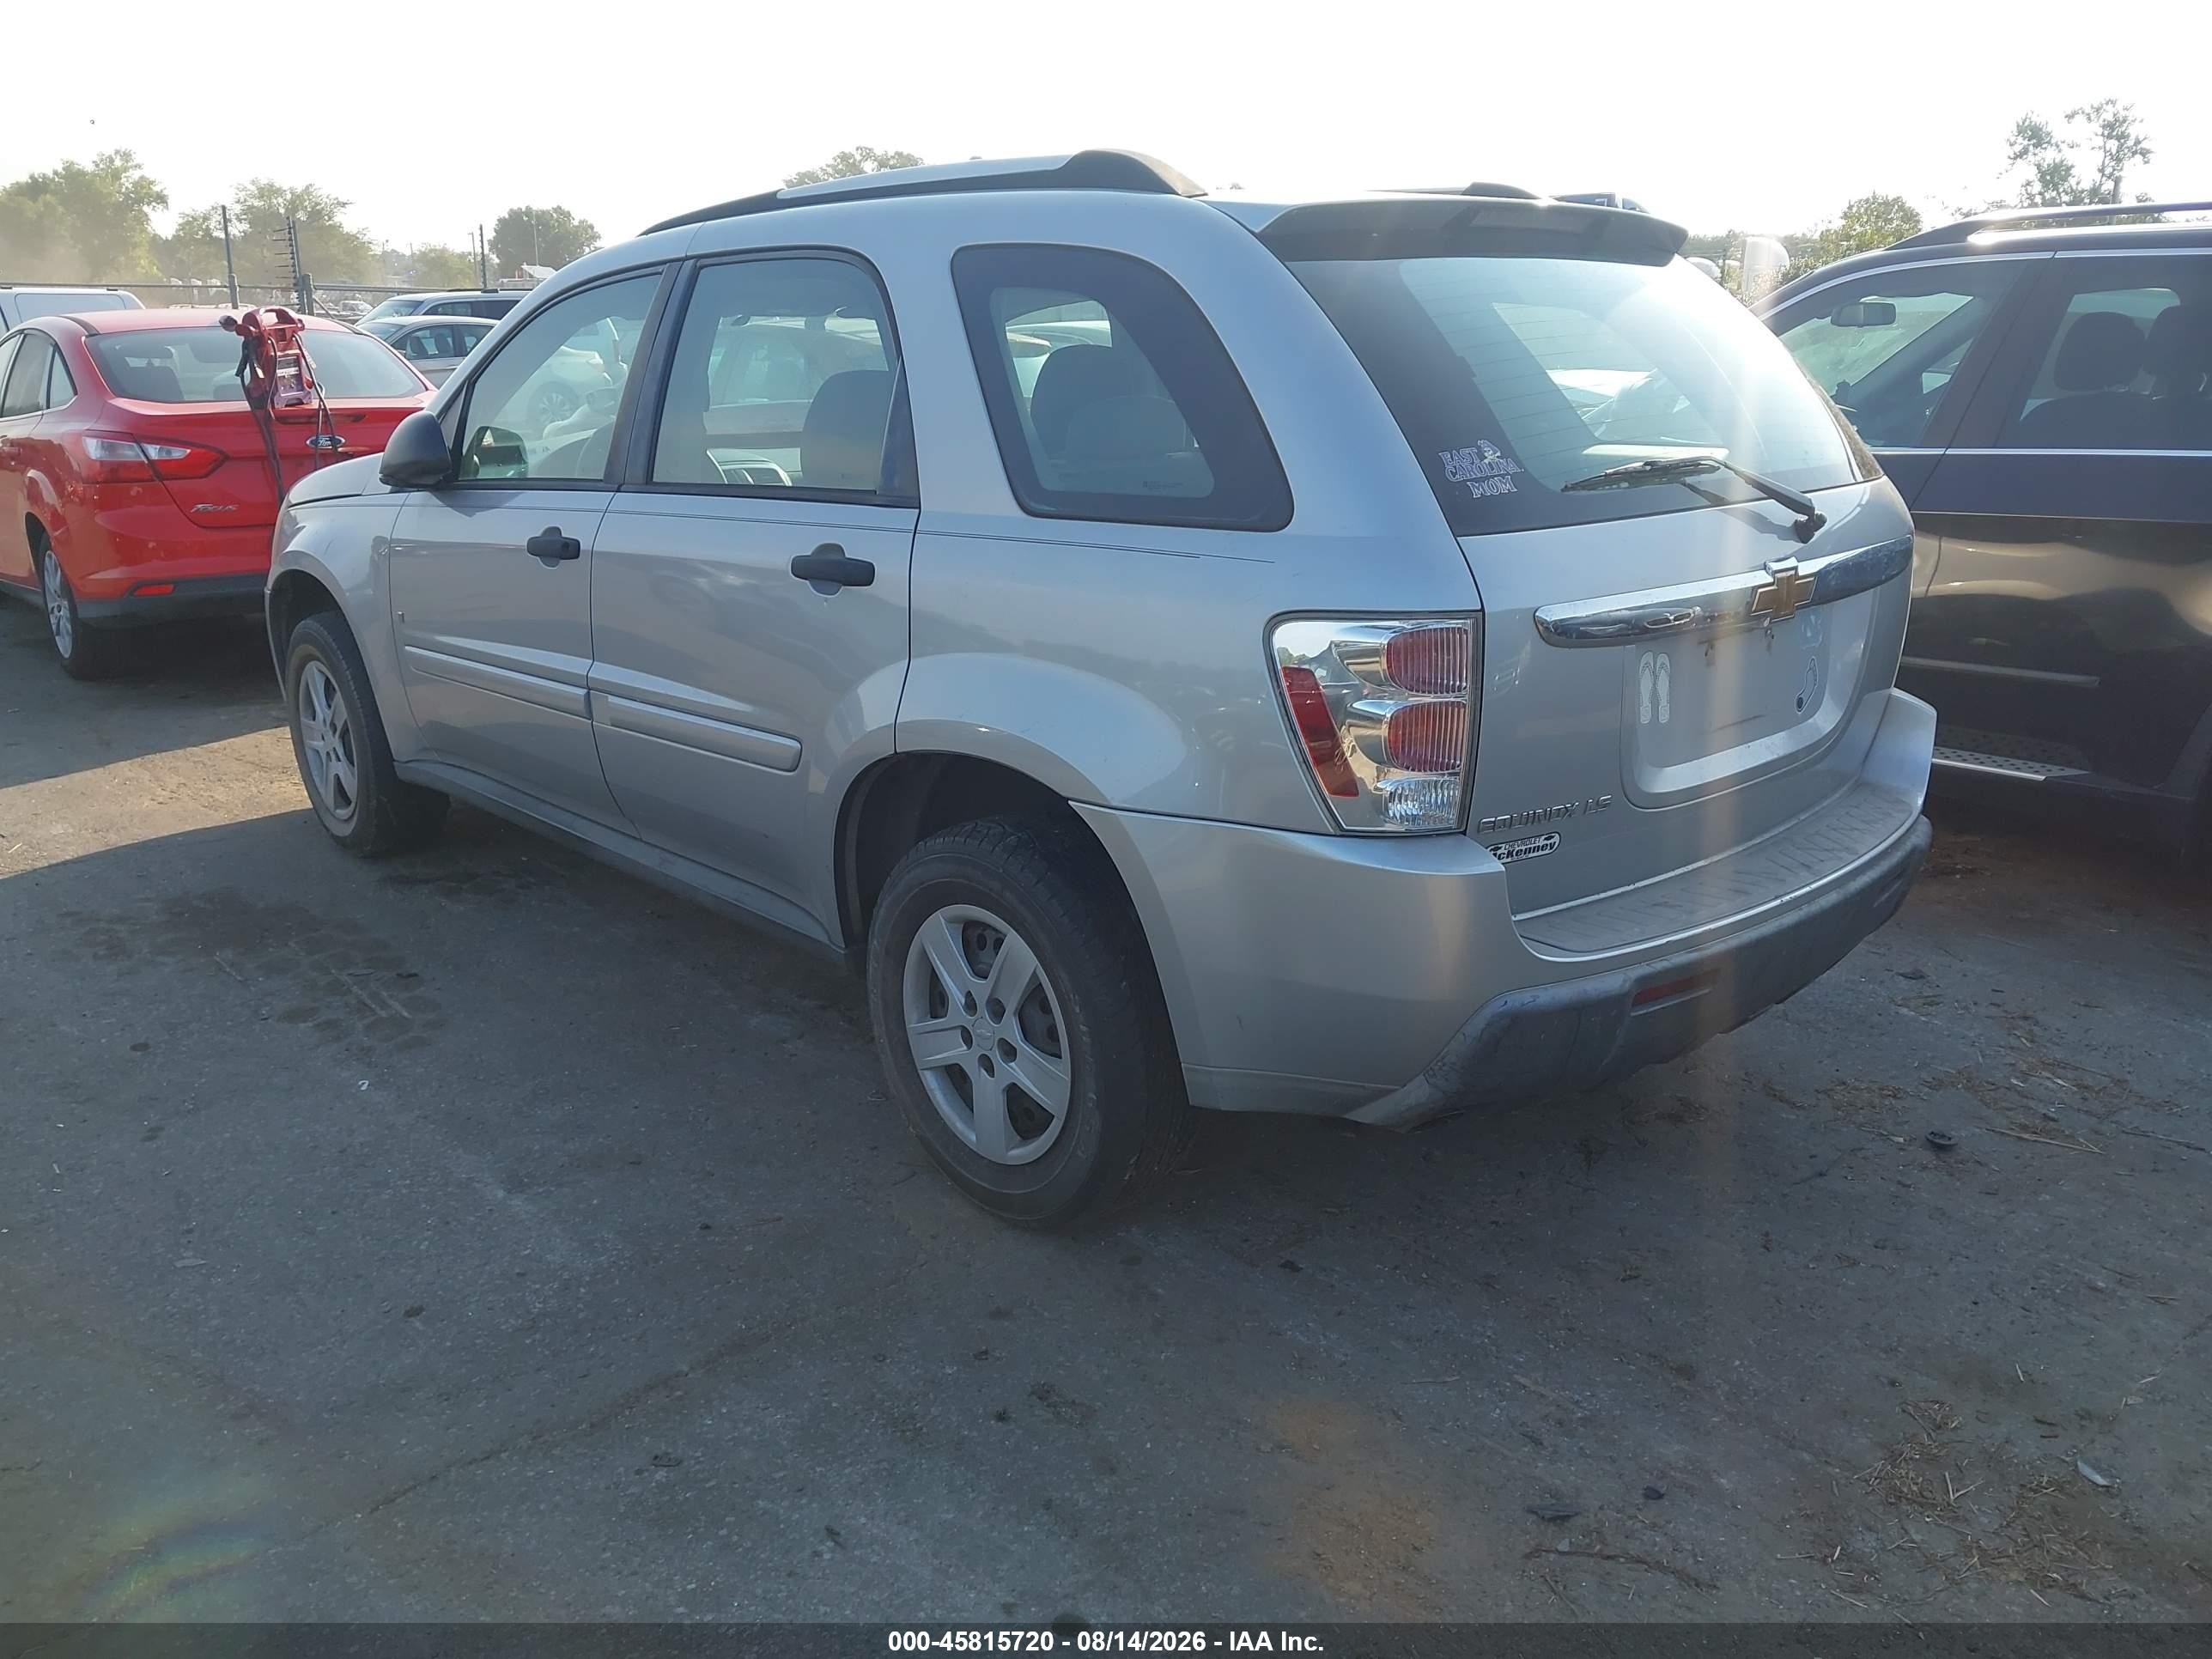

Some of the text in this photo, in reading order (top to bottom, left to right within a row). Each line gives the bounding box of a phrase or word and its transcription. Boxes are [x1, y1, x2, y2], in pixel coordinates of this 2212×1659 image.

[1439, 447, 1480, 466] EAST
[1468, 476, 1517, 498] MOM
[1477, 794, 1613, 833] EQUINOX LS
[1504, 837, 1541, 850] CHEVROLET
